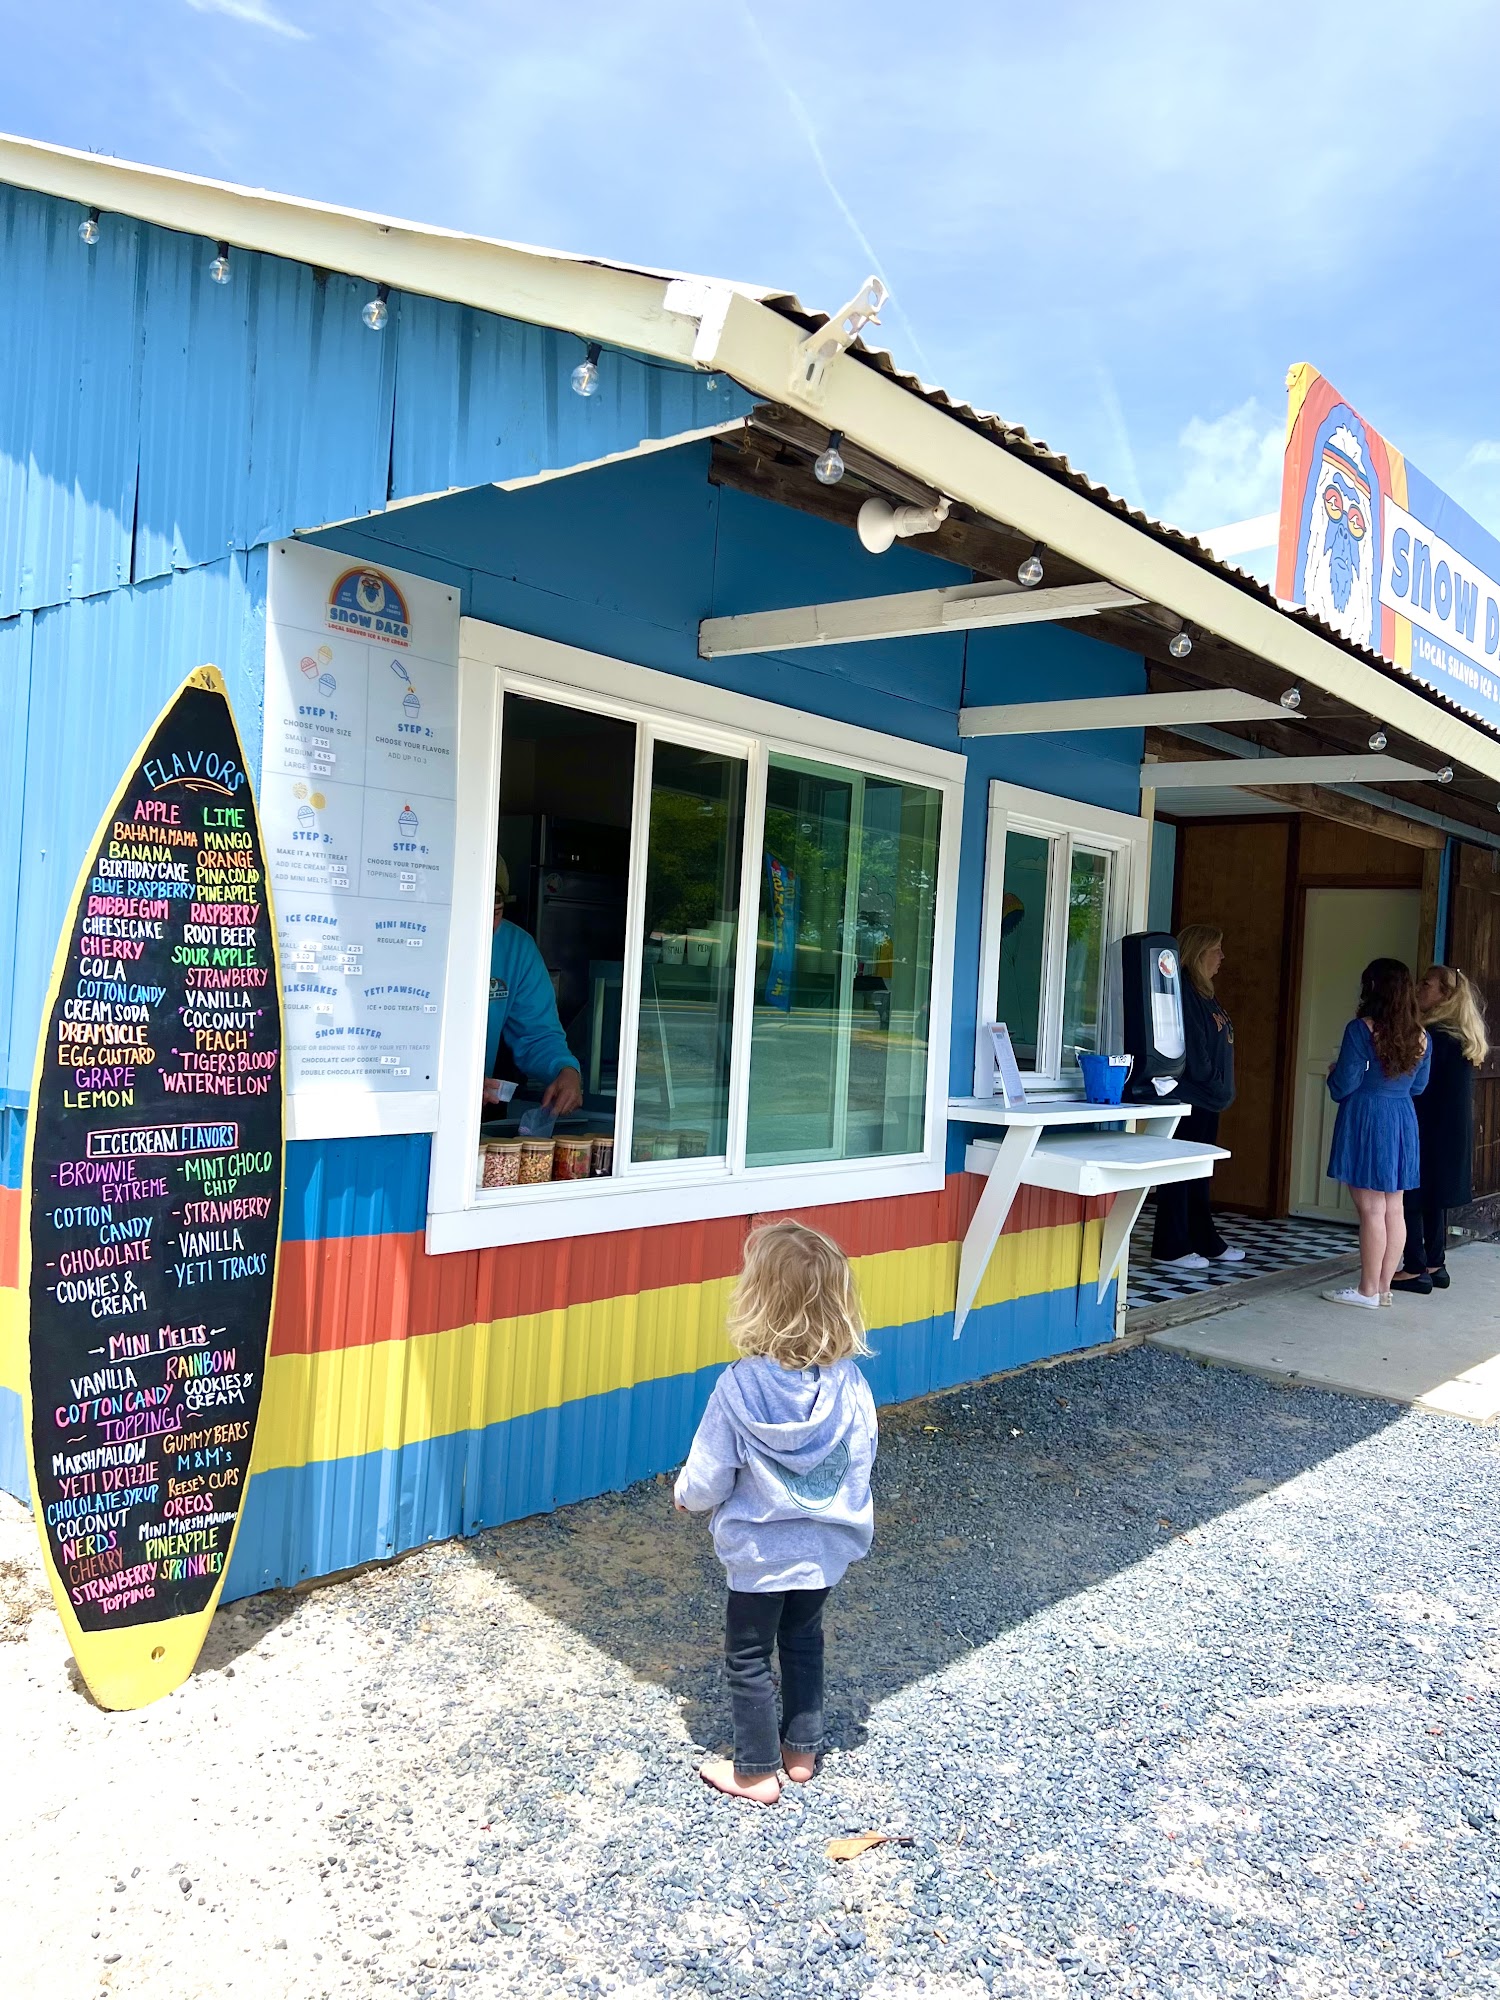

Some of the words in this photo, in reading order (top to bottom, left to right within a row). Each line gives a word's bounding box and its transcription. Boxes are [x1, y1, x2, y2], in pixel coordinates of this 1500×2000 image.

[330, 608, 372, 628] SNOW
[1485, 597, 1500, 655] D
[328, 623, 345, 632] LOCAL
[346, 628, 366, 636] SHAVED
[1419, 637, 1446, 671] LOCAL
[1447, 655, 1479, 690] SHAVED
[299, 706, 326, 718] STEP
[330, 712, 338, 720] 1:
[283, 719, 313, 729] CHOOSE
[315, 725, 334, 733] YOUR
[337, 729, 352, 737] SIZE
[398, 723, 422, 734] STEP
[425, 729, 433, 737] 2:
[314, 738, 328, 747] 3.95
[375, 736, 402, 747] CHOOSE
[403, 741, 421, 750] YOUR
[422, 744, 450, 755] FLAVORS
[388, 752, 400, 760] ADD
[143, 751, 245, 791] FLAVORS
[134, 800, 181, 825] APPLE
[203, 807, 245, 828] LIME
[204, 832, 252, 850] MANGO
[292, 831, 319, 841] STEP
[323, 834, 333, 844] 3:
[393, 843, 417, 851] STEP
[109, 841, 172, 862] BANANA
[197, 851, 254, 869] ORANGE
[277, 848, 295, 856] MAKE
[312, 851, 326, 859] YETI
[328, 853, 348, 861] TREAT
[275, 860, 289, 868] ADD
[291, 862, 302, 870] ICE
[368, 858, 391, 867] CHOOSE
[393, 860, 409, 868] YOUR
[410, 862, 439, 871] TOPPINGS
[92, 877, 123, 895] BLUE
[128, 881, 196, 900] RASPBERRY
[197, 885, 257, 903] PINEAPPLE
[88, 895, 169, 919] BUBBLEGUM
[191, 903, 259, 925] RASPBERRY
[83, 917, 164, 939] CHEESECAKE
[286, 914, 301, 922] ICE
[305, 914, 338, 926] CREAM
[375, 921, 397, 930] MINI
[400, 921, 427, 932] MELTS
[184, 924, 218, 944] ROOT
[221, 927, 256, 946] BEER
[81, 937, 144, 960] CHERRY
[171, 946, 210, 965] SOUR
[212, 948, 257, 967] APPLE
[79, 957, 126, 981] COLA
[185, 968, 268, 988] STRAWBERRY
[77, 979, 127, 1001] COTTON
[129, 984, 166, 1007] CANDY
[185, 989, 252, 1009] VANILLA
[284, 984, 338, 996] ILKSHAKES
[364, 987, 384, 997] YETI
[388, 986, 430, 998] PAWSICLE
[64, 1000, 112, 1022] CREAM
[114, 1004, 150, 1022] SODA
[58, 1020, 148, 1045] DREAMSICLE
[315, 1027, 344, 1038] SNOW
[348, 1027, 382, 1039] MELTER
[58, 1044, 96, 1067] EGG
[98, 1047, 155, 1065] CUSTARD
[76, 1067, 135, 1088] GRAPE
[64, 1089, 134, 1108] LEMON
[181, 1126, 234, 1150] FLAVORS
[228, 1152, 272, 1177] CHOCO
[102, 1177, 169, 1203] EXTREME
[203, 1179, 237, 1196] CHIP
[100, 1216, 153, 1245] CANDY
[218, 1253, 267, 1280] TRACKS
[124, 1270, 138, 1293] &
[91, 1291, 147, 1318] CREAM
[109, 1332, 150, 1360] MINI
[159, 1325, 207, 1350] MELTS
[166, 1348, 236, 1381] RAINBOW
[70, 1367, 138, 1400] VANILLA
[184, 1373, 241, 1396] COOKIES
[55, 1394, 123, 1428] COTTON
[125, 1383, 174, 1413] CANDY
[186, 1389, 245, 1410] CREAM
[97, 1404, 184, 1441] TOPPINGS
[163, 1430, 214, 1454] GUMMY
[214, 1421, 250, 1442] BEARS
[53, 1439, 147, 1476] MARSHMALLOW
[58, 1475, 96, 1498] YETI
[101, 1461, 160, 1490] DRIZZLE
[209, 1468, 240, 1489] CUPS
[47, 1491, 119, 1526] CHOCOLATE
[122, 1484, 159, 1507] SYRUP
[163, 1493, 214, 1518] OREOS
[56, 1508, 130, 1543] COCONUT
[139, 1521, 166, 1541] MINI
[62, 1530, 117, 1565] NERDS
[146, 1527, 219, 1561] PINEAPPLE
[70, 1547, 123, 1585] CHERRY
[72, 1562, 158, 1606] STRAWBERRY
[97, 1585, 155, 1614] TOPPING
